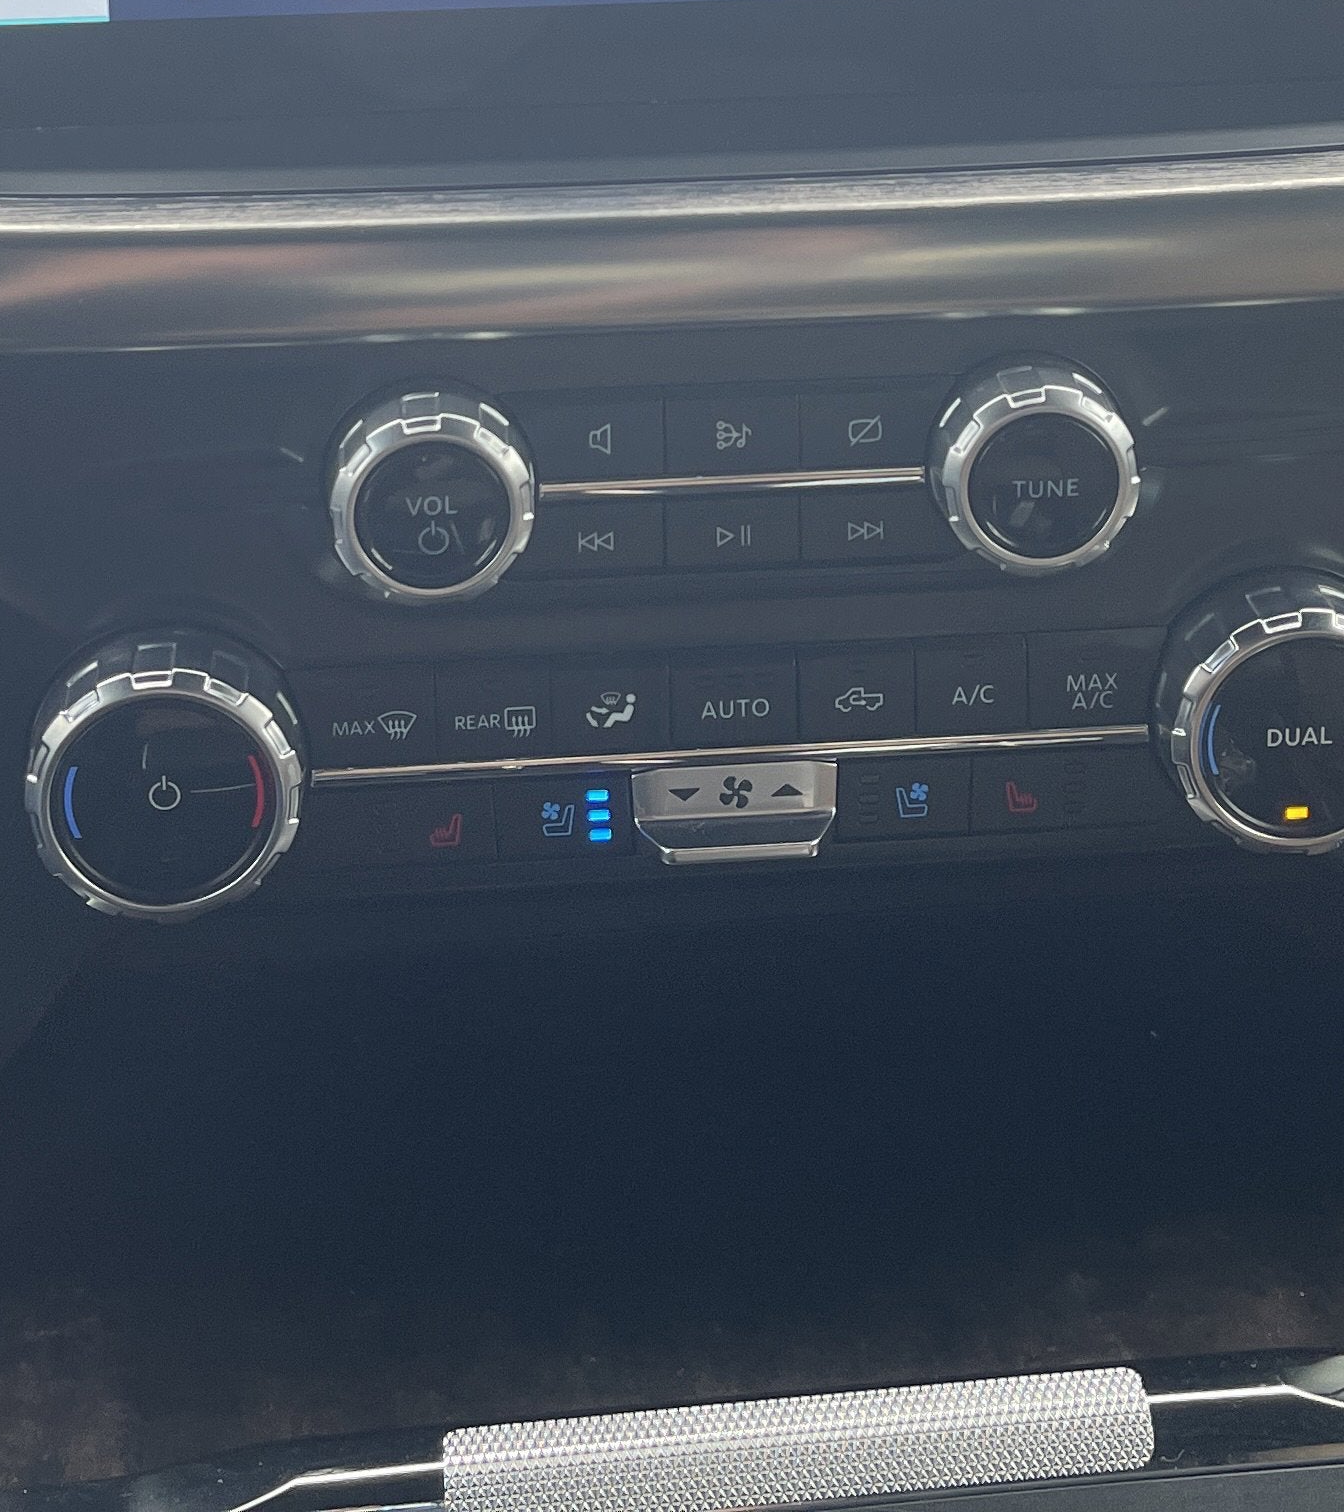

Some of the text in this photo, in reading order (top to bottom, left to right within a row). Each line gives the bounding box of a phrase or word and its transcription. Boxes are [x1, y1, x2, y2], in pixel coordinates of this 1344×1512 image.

[1012, 477, 1080, 500] TUNE
[405, 494, 459, 517] VOL
[1066, 672, 1119, 693] MAX
[951, 683, 995, 707] A/C
[1071, 689, 1114, 710] A/C
[700, 697, 771, 721] AUTO
[332, 719, 376, 738] MAX
[454, 713, 502, 731] REAR
[1266, 725, 1334, 748] DUAL
